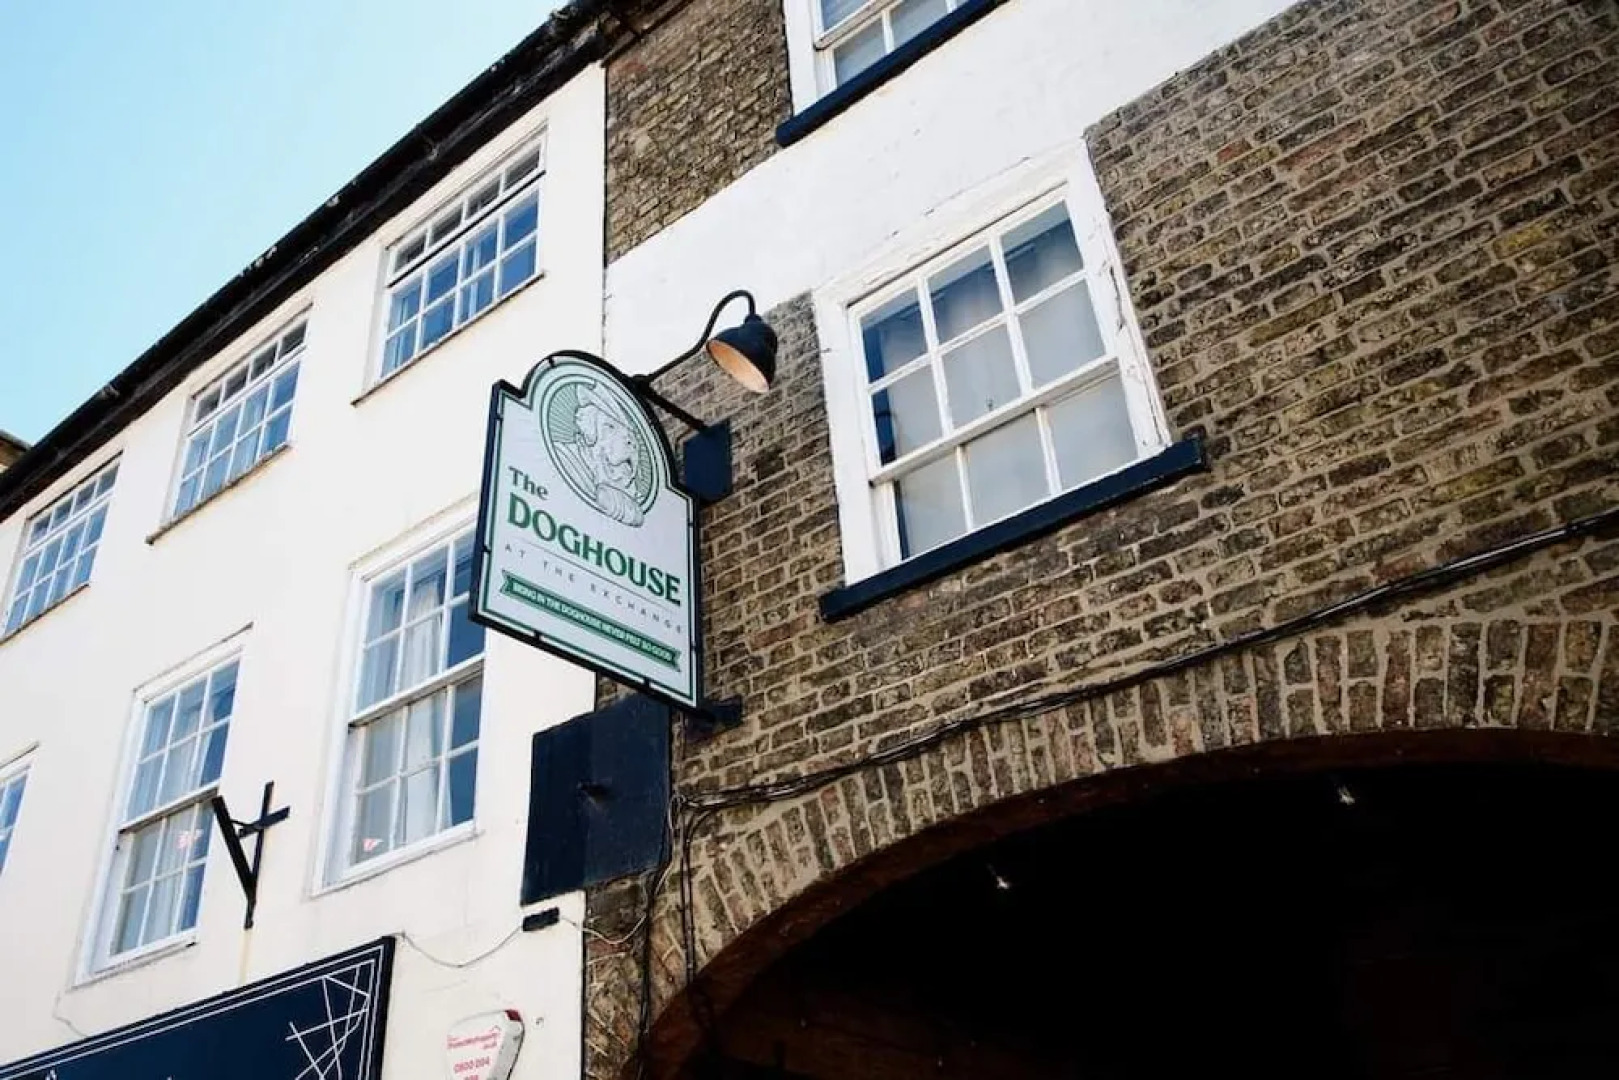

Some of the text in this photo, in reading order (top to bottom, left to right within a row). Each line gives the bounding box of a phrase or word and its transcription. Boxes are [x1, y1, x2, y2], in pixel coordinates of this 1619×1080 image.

[508, 466, 549, 499] The
[507, 492, 681, 607] DOGHOUSE
[504, 543, 681, 634] AT THE EXCHANGE
[561, 603, 601, 629] DOGHOUSE
